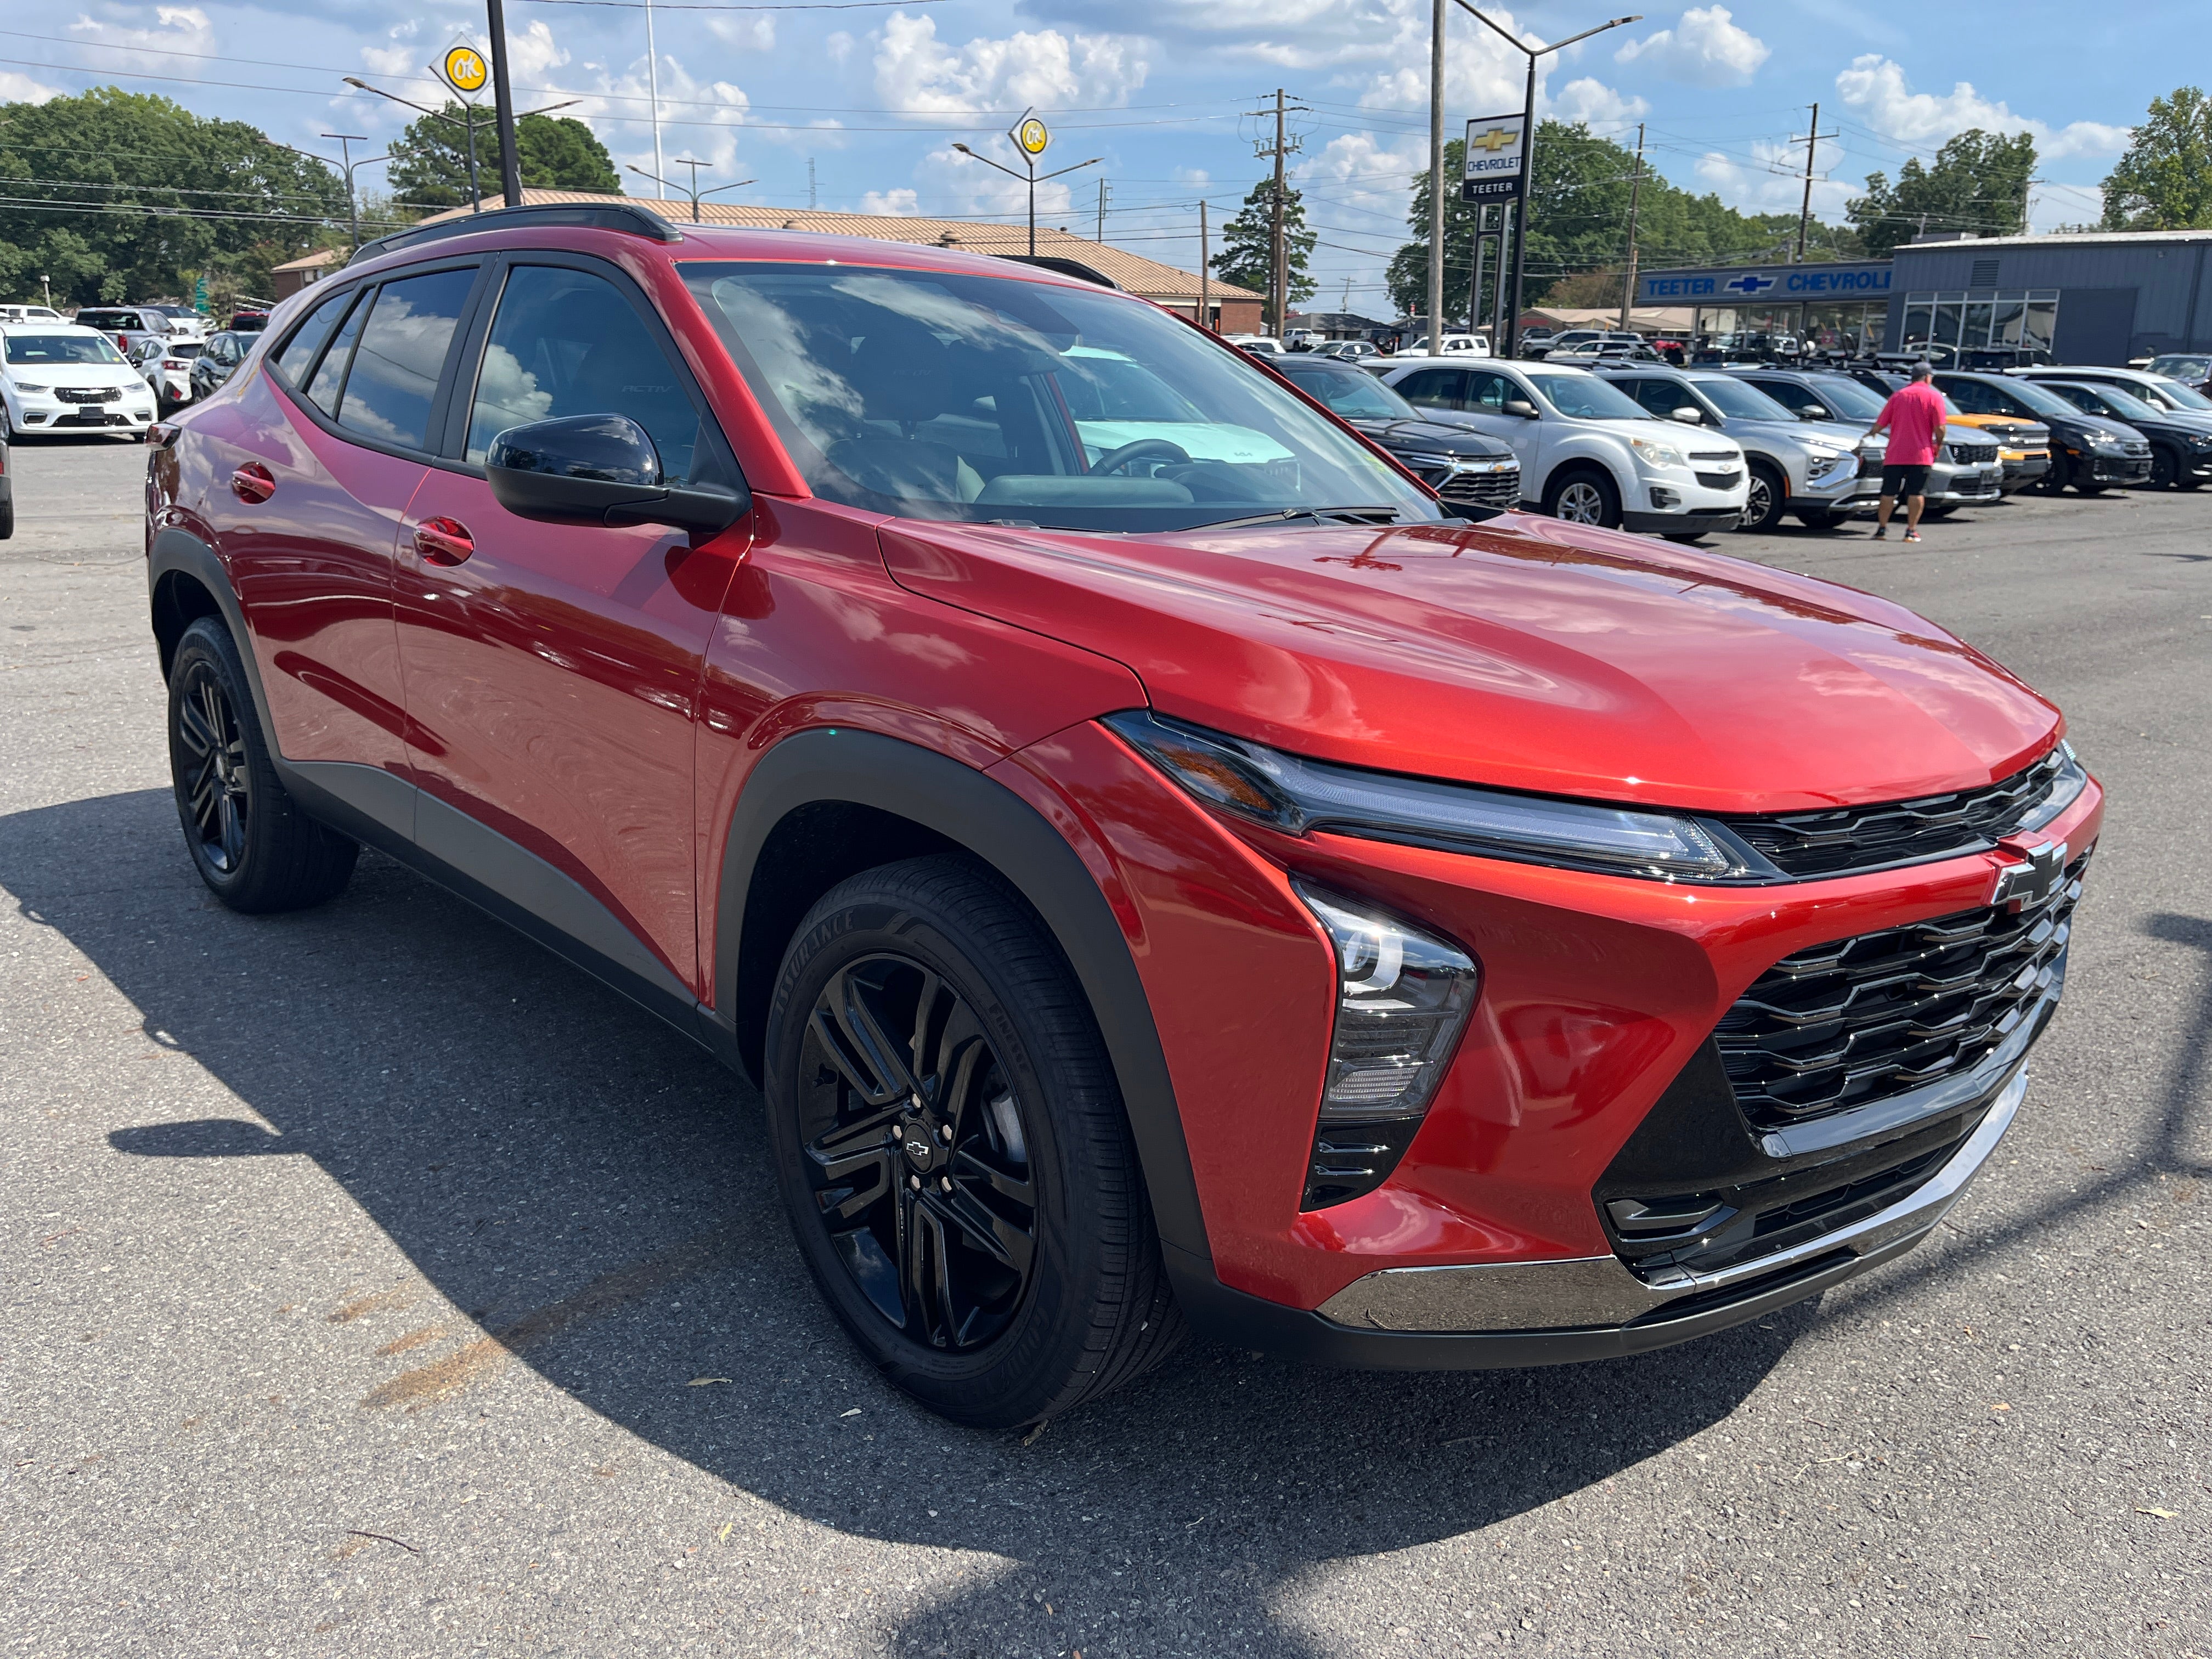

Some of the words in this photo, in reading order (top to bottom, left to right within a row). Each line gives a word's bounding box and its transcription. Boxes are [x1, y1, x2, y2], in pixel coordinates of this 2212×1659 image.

[1468, 156, 1521, 172] CHEVROLET
[1471, 182, 1513, 194] TEETER
[1647, 278, 1716, 296] TEETER
